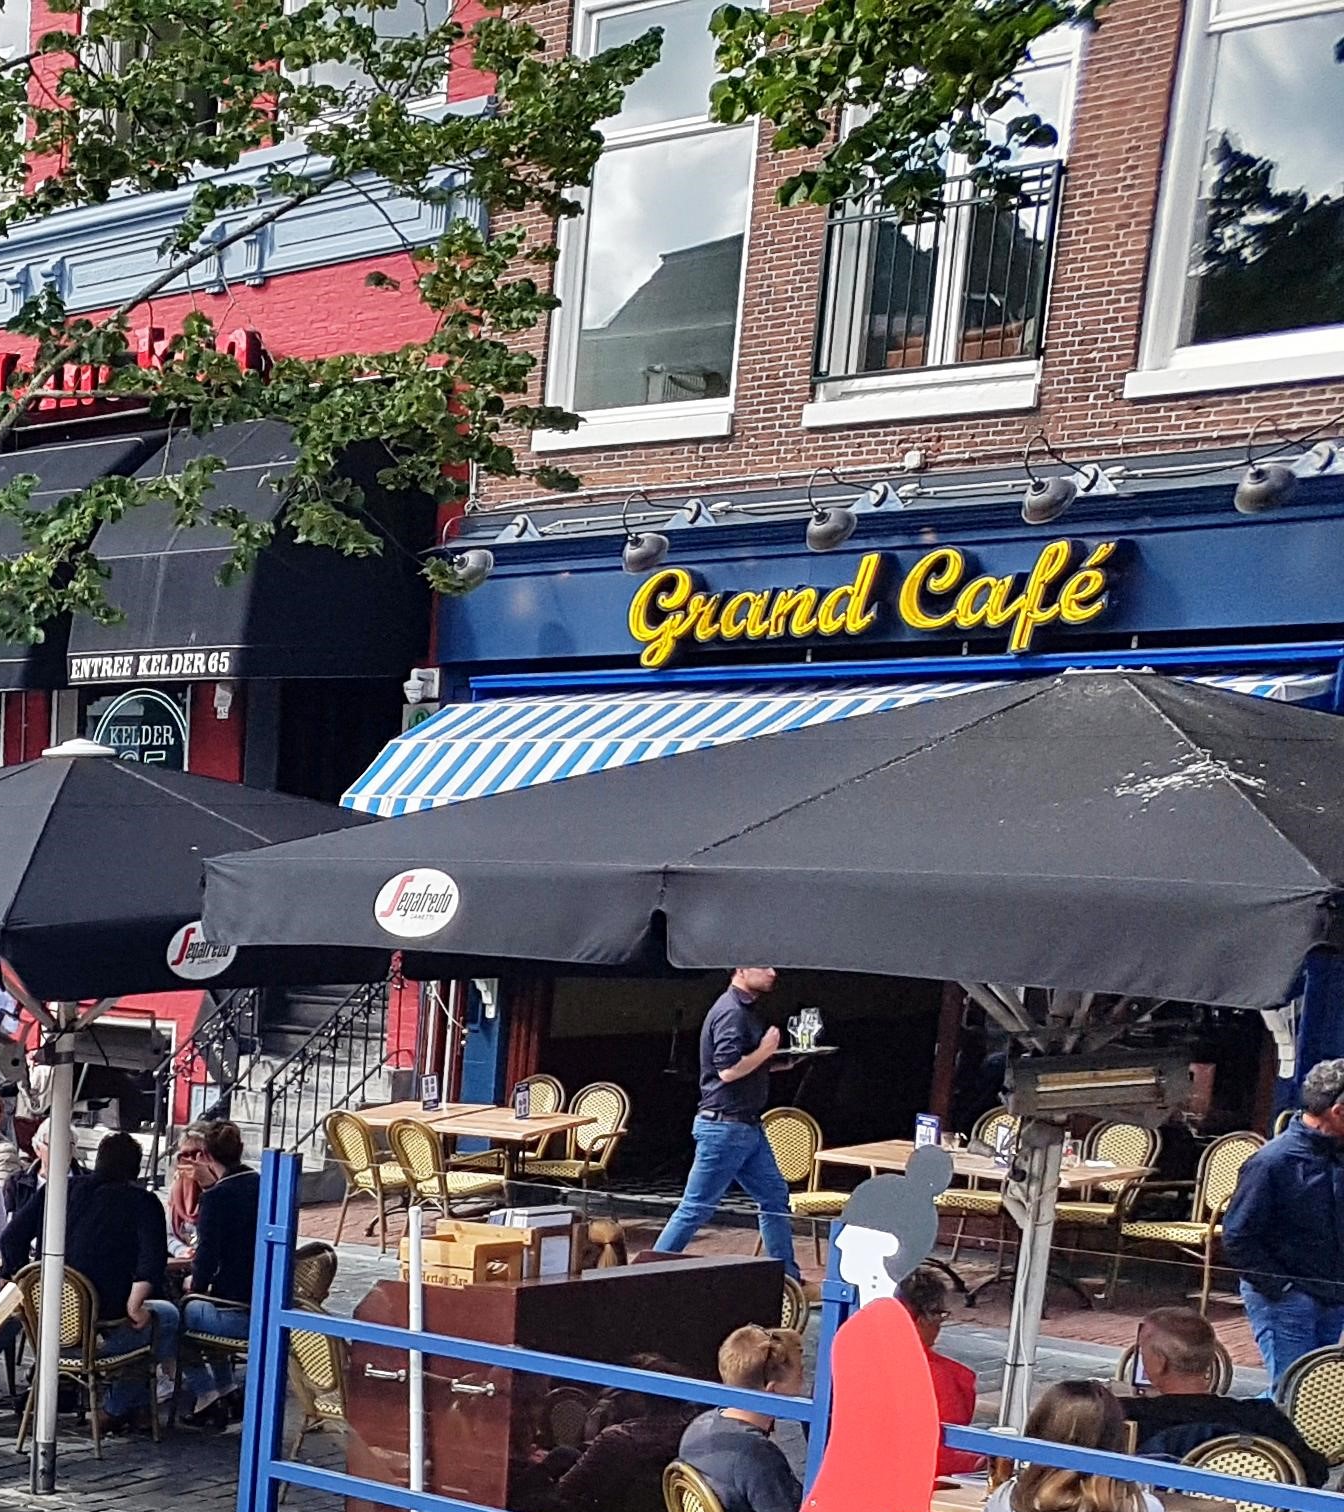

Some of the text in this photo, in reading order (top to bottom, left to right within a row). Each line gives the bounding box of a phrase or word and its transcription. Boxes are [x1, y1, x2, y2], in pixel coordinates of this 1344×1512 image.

[628, 538, 1115, 669] Grand Café
[71, 651, 230, 679] ENTREE KELDER 65
[109, 725, 174, 746] KELDER
[379, 876, 453, 917] Segafredo
